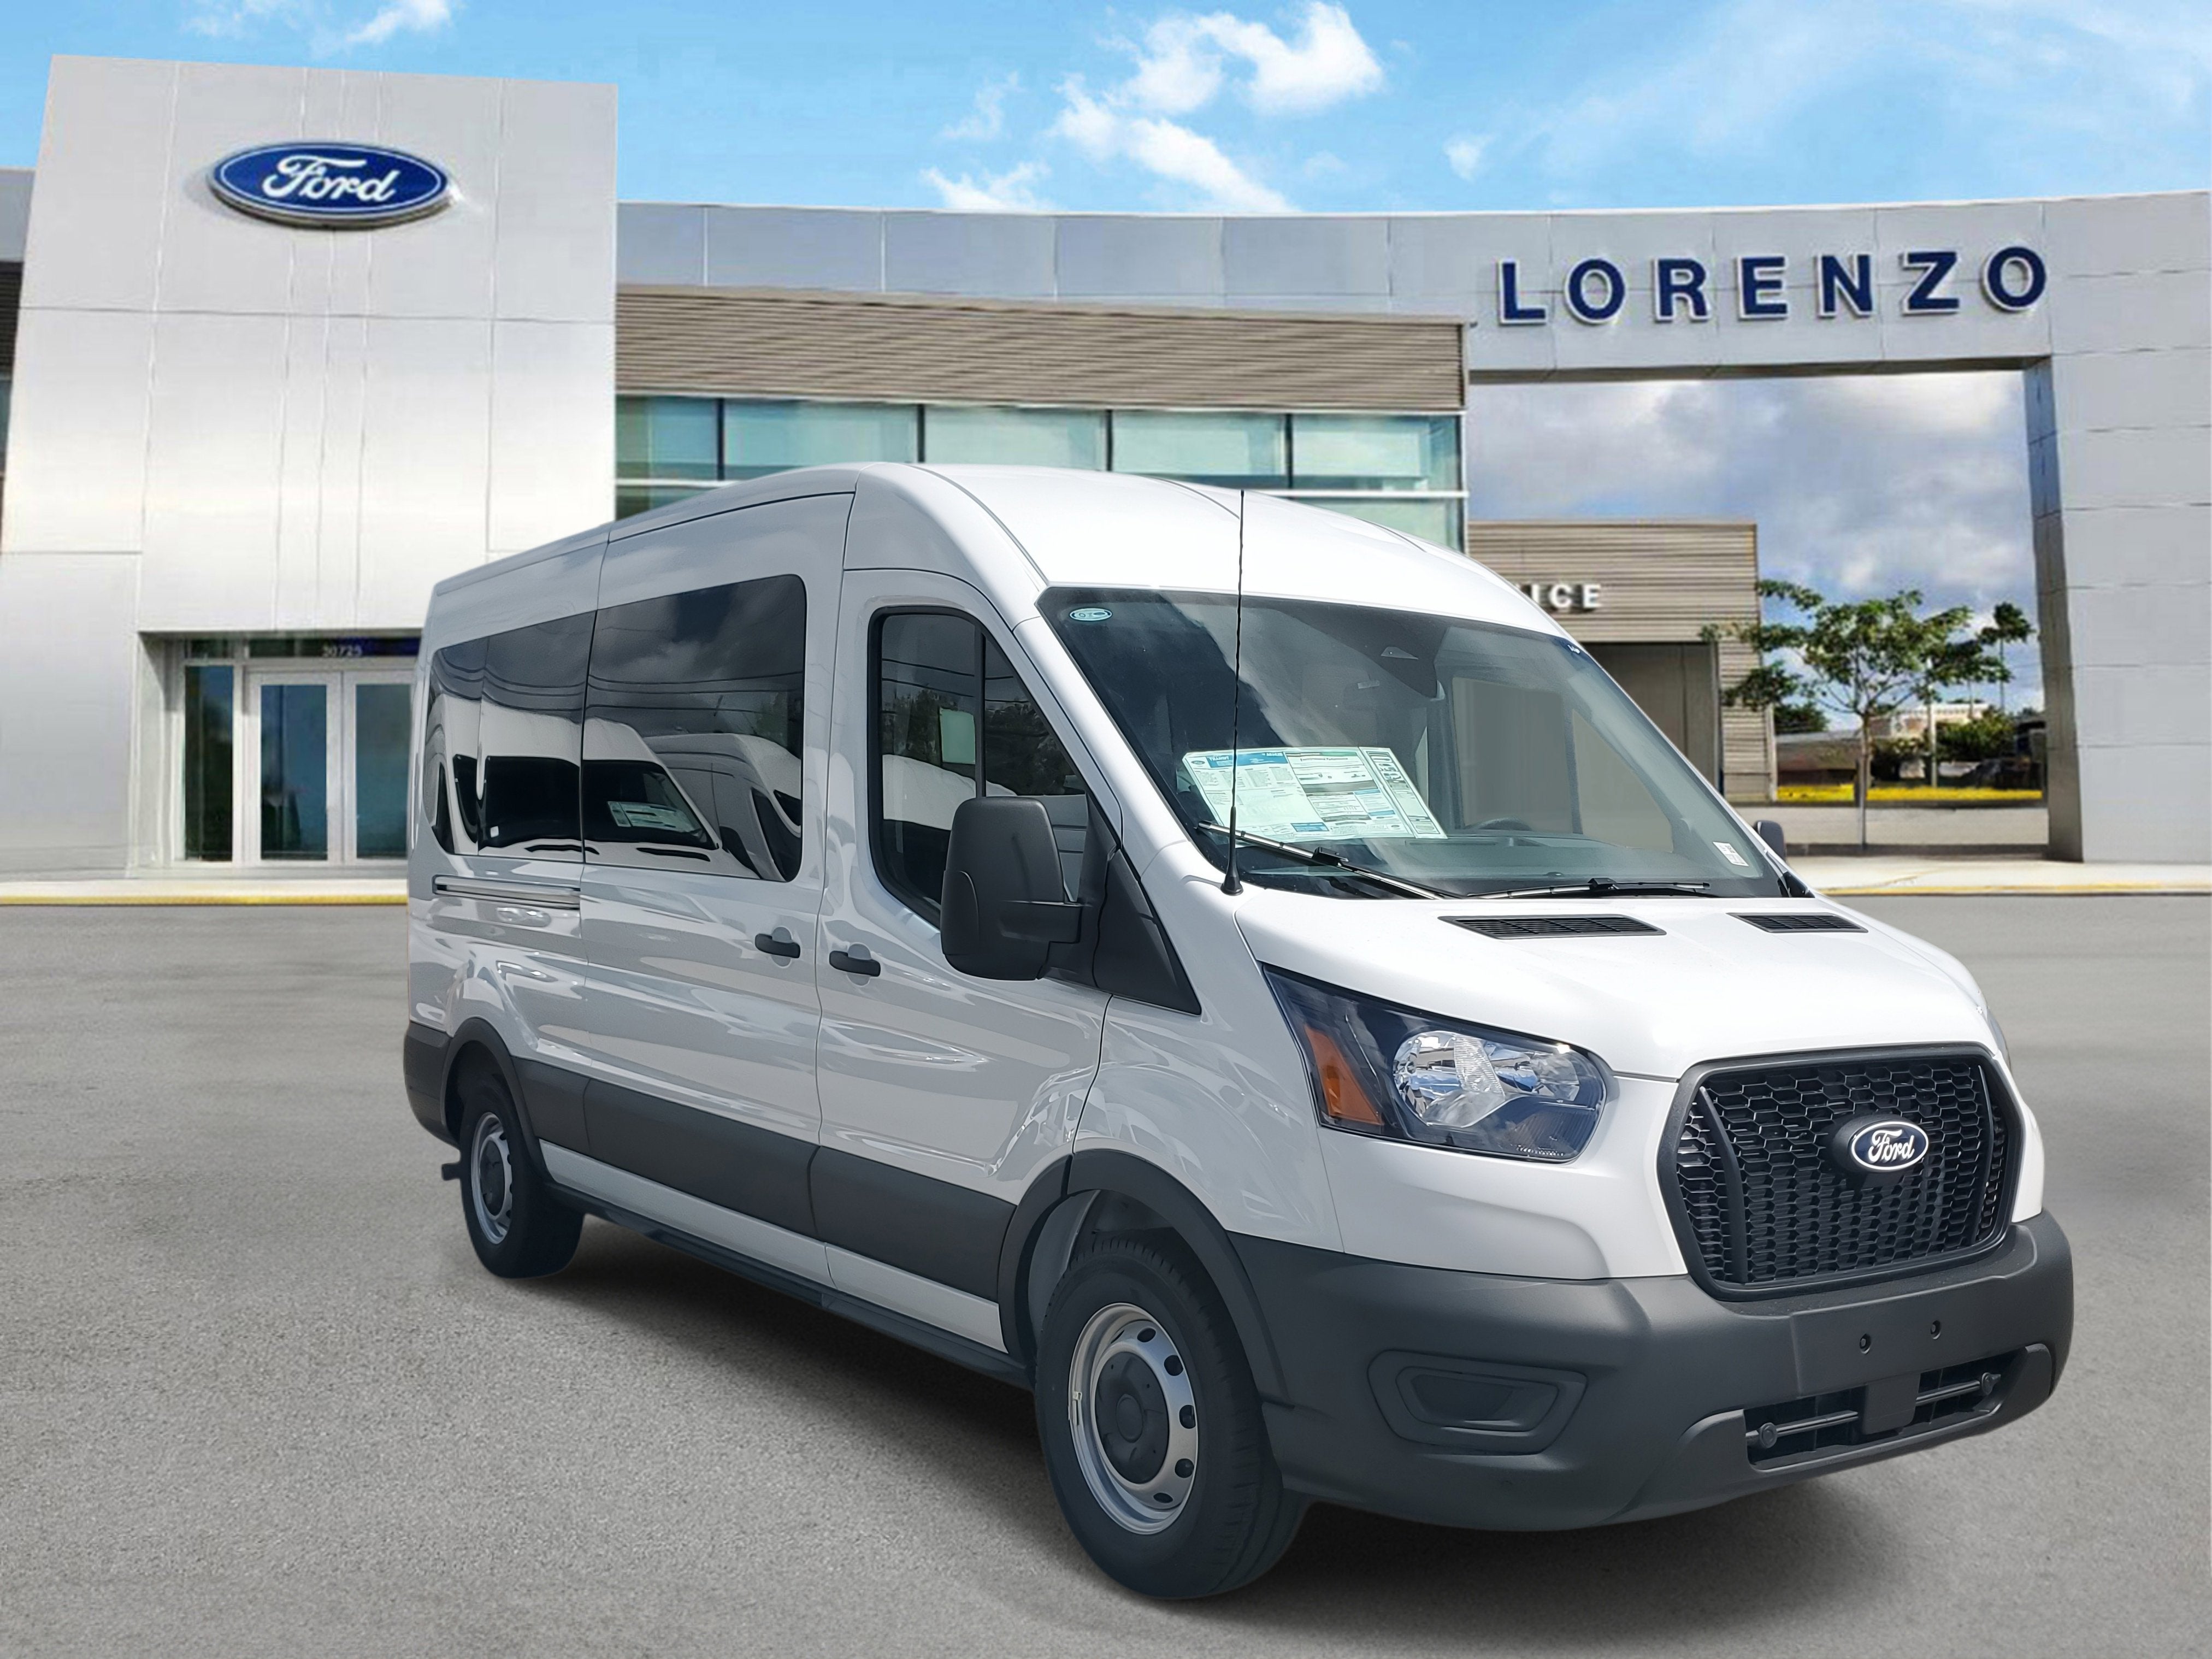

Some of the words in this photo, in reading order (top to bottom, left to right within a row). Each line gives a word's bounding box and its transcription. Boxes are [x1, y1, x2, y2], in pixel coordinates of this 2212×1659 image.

[262, 154, 401, 202] Ford
[1497, 245, 2047, 326] LORENZO
[1516, 583, 1602, 609] ICE
[1868, 1129, 1915, 1163] Ford
